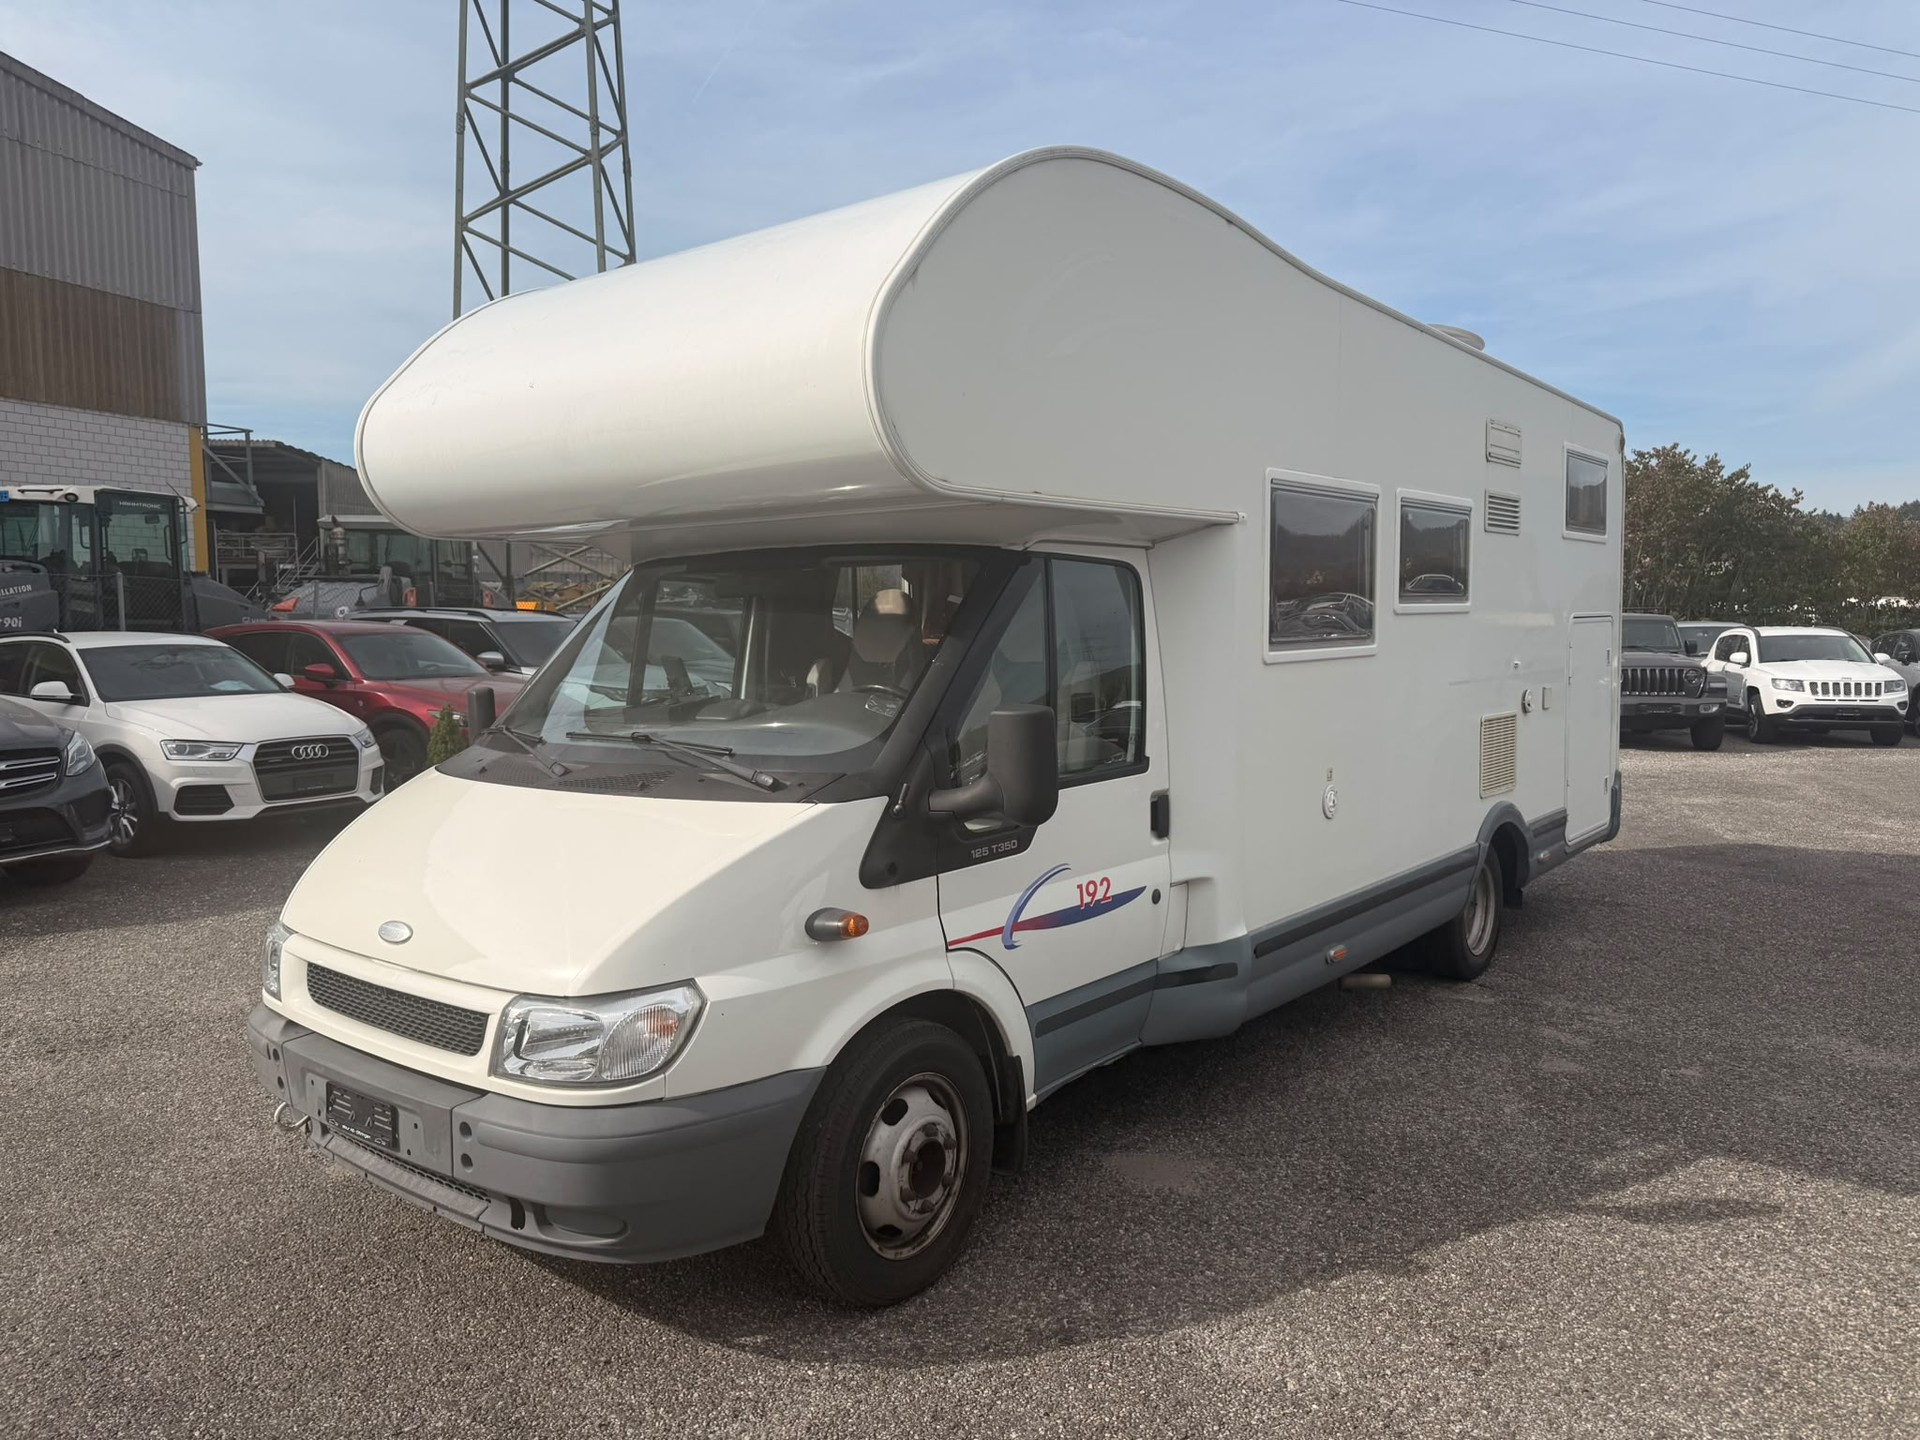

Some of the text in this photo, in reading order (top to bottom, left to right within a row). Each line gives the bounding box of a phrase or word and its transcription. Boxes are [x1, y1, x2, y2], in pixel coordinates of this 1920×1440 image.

[0, 584, 32, 596] LLATION
[971, 839, 1018, 859] 125 T350
[1076, 876, 1113, 910] 192
